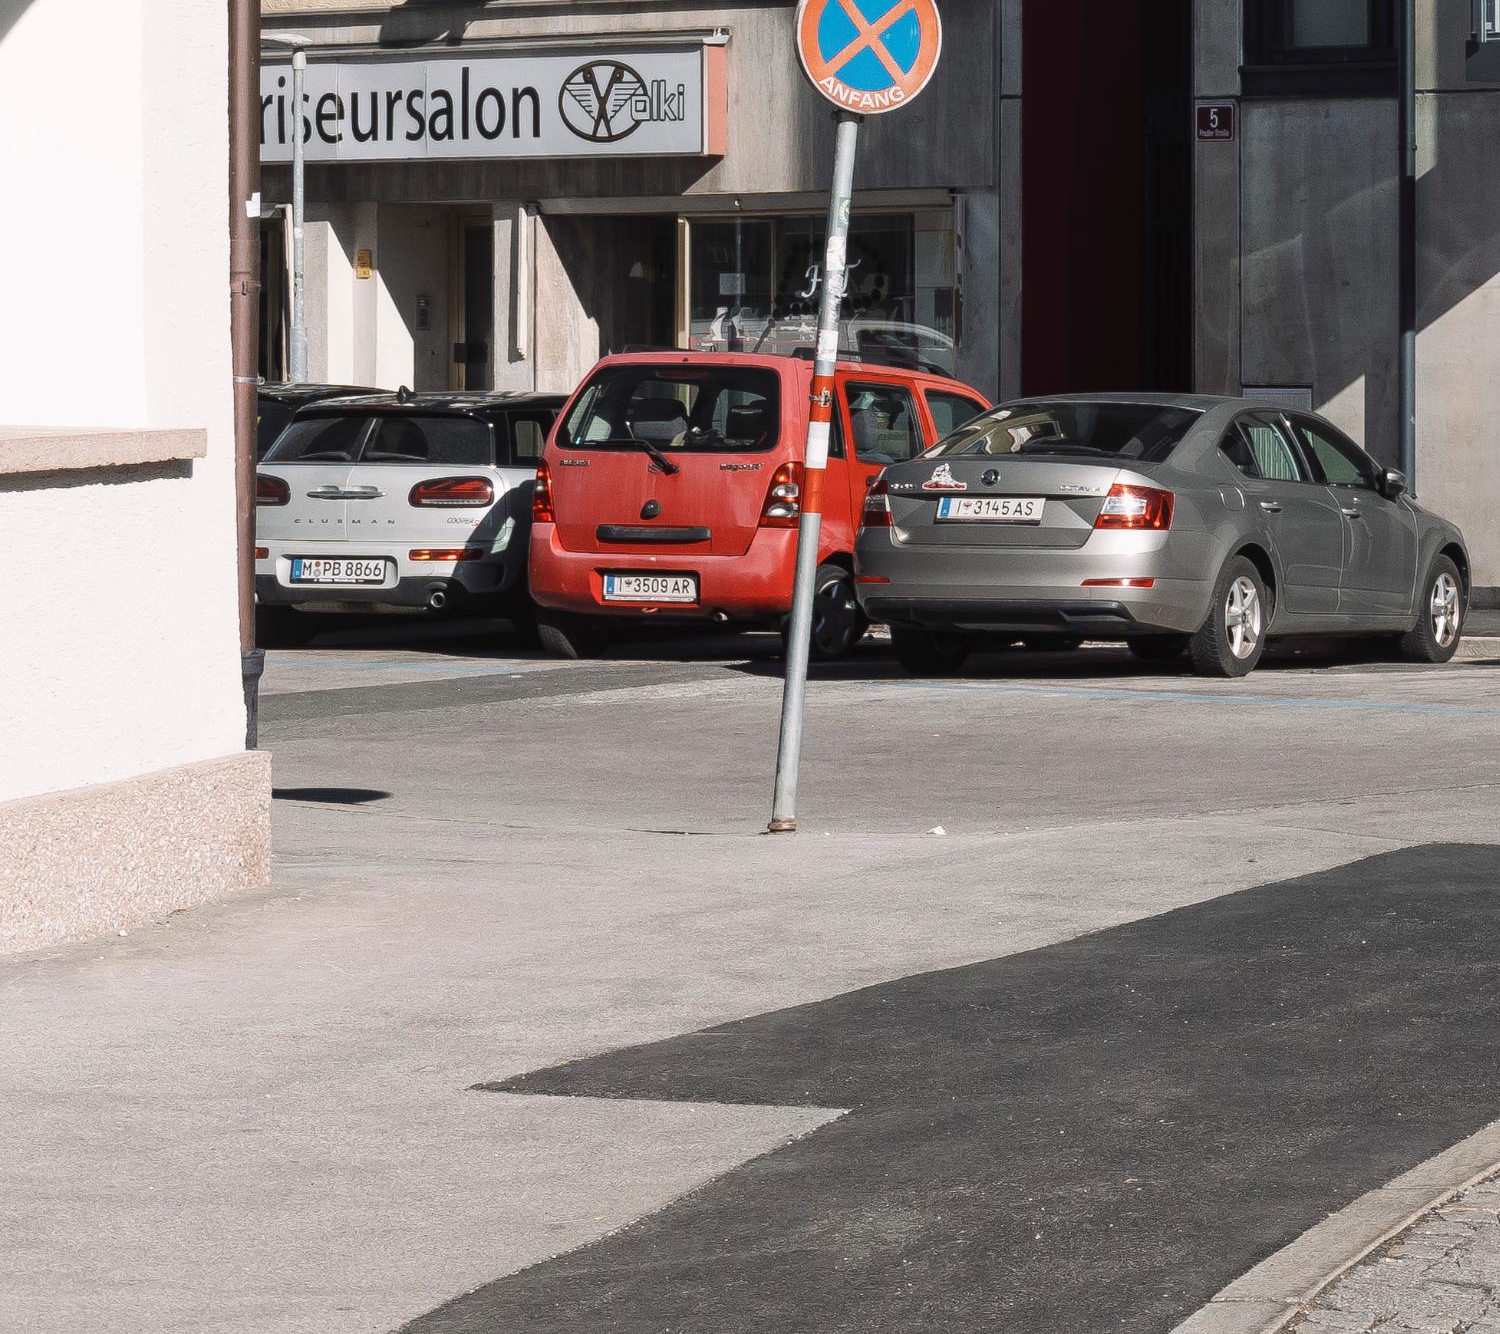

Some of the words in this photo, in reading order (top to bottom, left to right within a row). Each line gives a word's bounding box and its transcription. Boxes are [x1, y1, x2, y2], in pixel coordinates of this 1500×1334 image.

[819, 76, 905, 108] ANFANG
[260, 66, 541, 144] riseursalon
[1210, 108, 1219, 128] 5
[1058, 484, 1101, 492] OCTAVA
[974, 500, 1010, 516] 3145
[1013, 500, 1034, 516] AS
[302, 562, 312, 576] M
[323, 561, 341, 576] PB
[345, 562, 382, 577] 8866
[633, 578, 668, 594] 3509
[672, 579, 690, 594] AR
